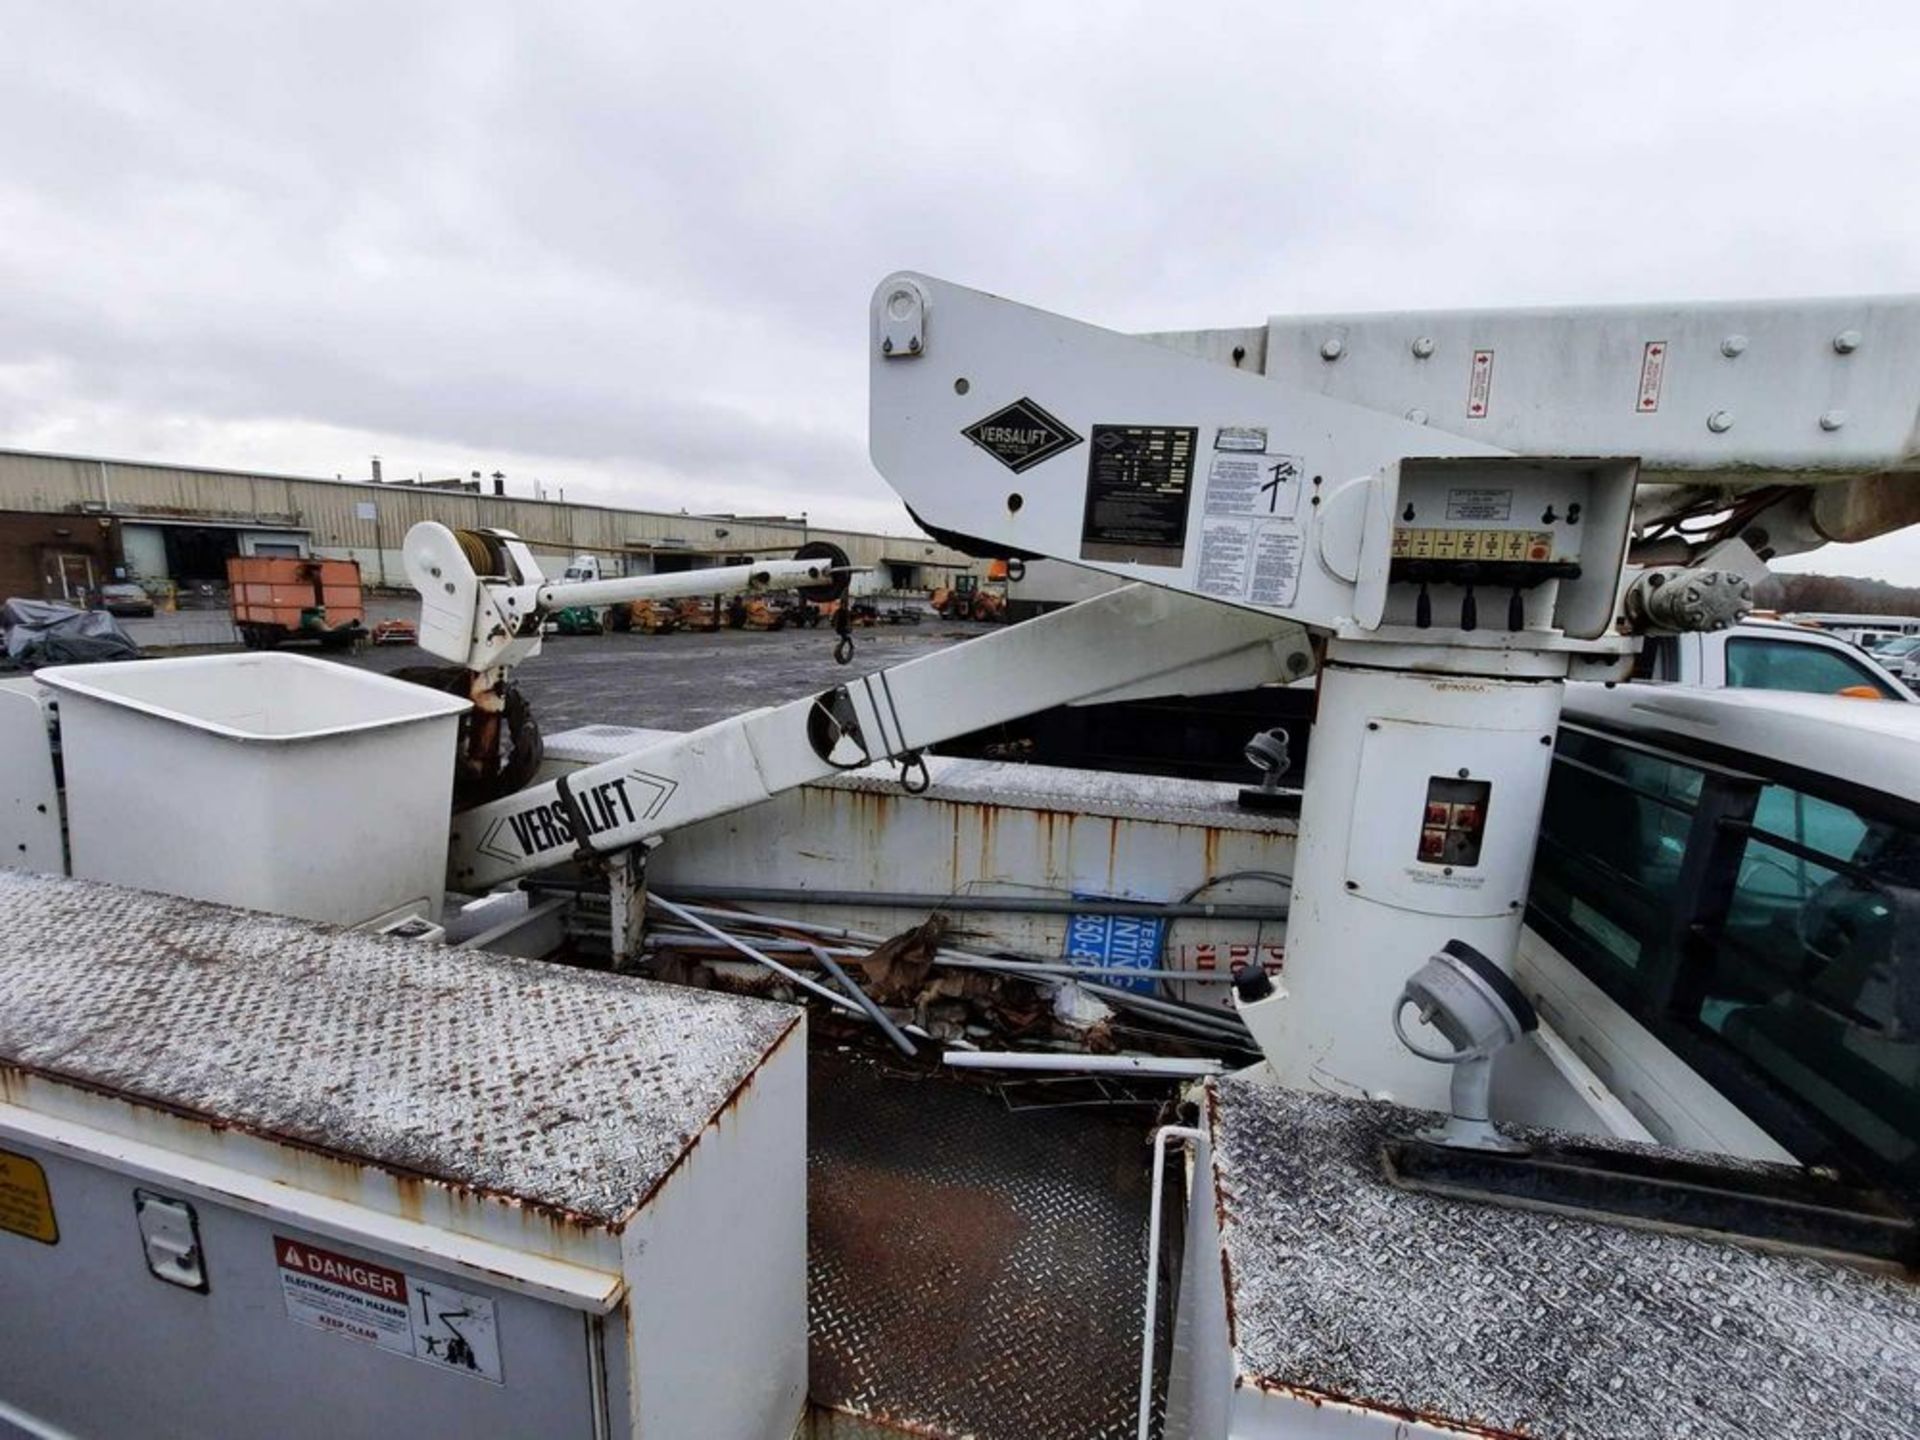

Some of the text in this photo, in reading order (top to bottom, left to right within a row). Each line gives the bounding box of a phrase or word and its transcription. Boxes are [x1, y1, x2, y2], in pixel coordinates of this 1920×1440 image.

[979, 425, 1048, 445] VERSALIFT
[508, 777, 636, 856] VERSLIFT
[284, 1274, 364, 1305] ELECTROCUTION
[365, 1299, 406, 1318] HAZARD
[308, 1253, 398, 1296] DANGER
